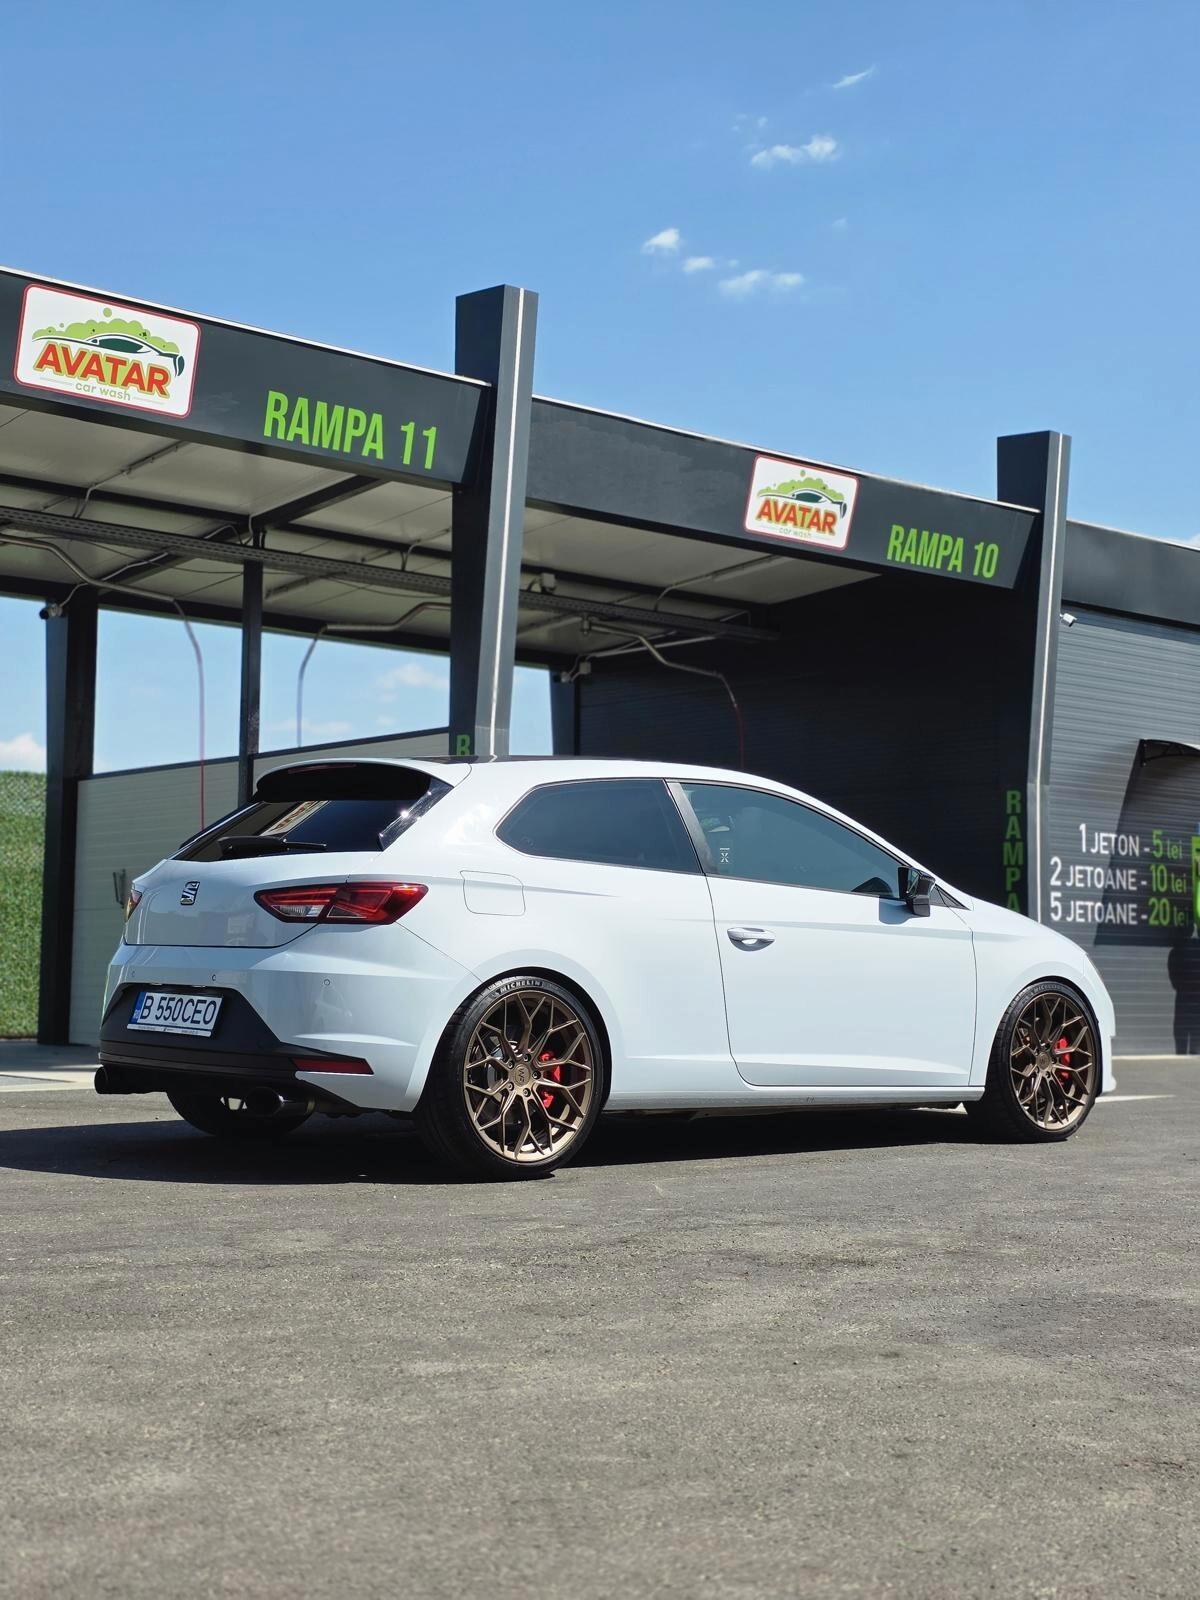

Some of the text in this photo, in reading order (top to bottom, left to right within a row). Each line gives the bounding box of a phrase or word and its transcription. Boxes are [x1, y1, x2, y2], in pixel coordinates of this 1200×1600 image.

[36, 342, 169, 398] AVATAR
[75, 380, 131, 401] car wash
[263, 390, 438, 470] RAMPA 11
[757, 499, 836, 534] AVATAR
[886, 524, 999, 579] RAMPA 10
[1003, 790, 1023, 913] RAMPA
[1079, 823, 1087, 853] 1
[1090, 832, 1140, 857] JETON
[1152, 829, 1164, 858] 5
[1166, 840, 1183, 860] lei
[1050, 856, 1062, 886] 2
[1065, 865, 1138, 891] JETOANE
[1150, 864, 1168, 893] 10
[1171, 872, 1187, 894] lei
[1050, 892, 1062, 922] 5
[1065, 901, 1138, 925] JETOANE
[1148, 898, 1171, 926] 20
[500, 980, 541, 992] MICHELIN
[140, 996, 217, 1025] B 550CEO
